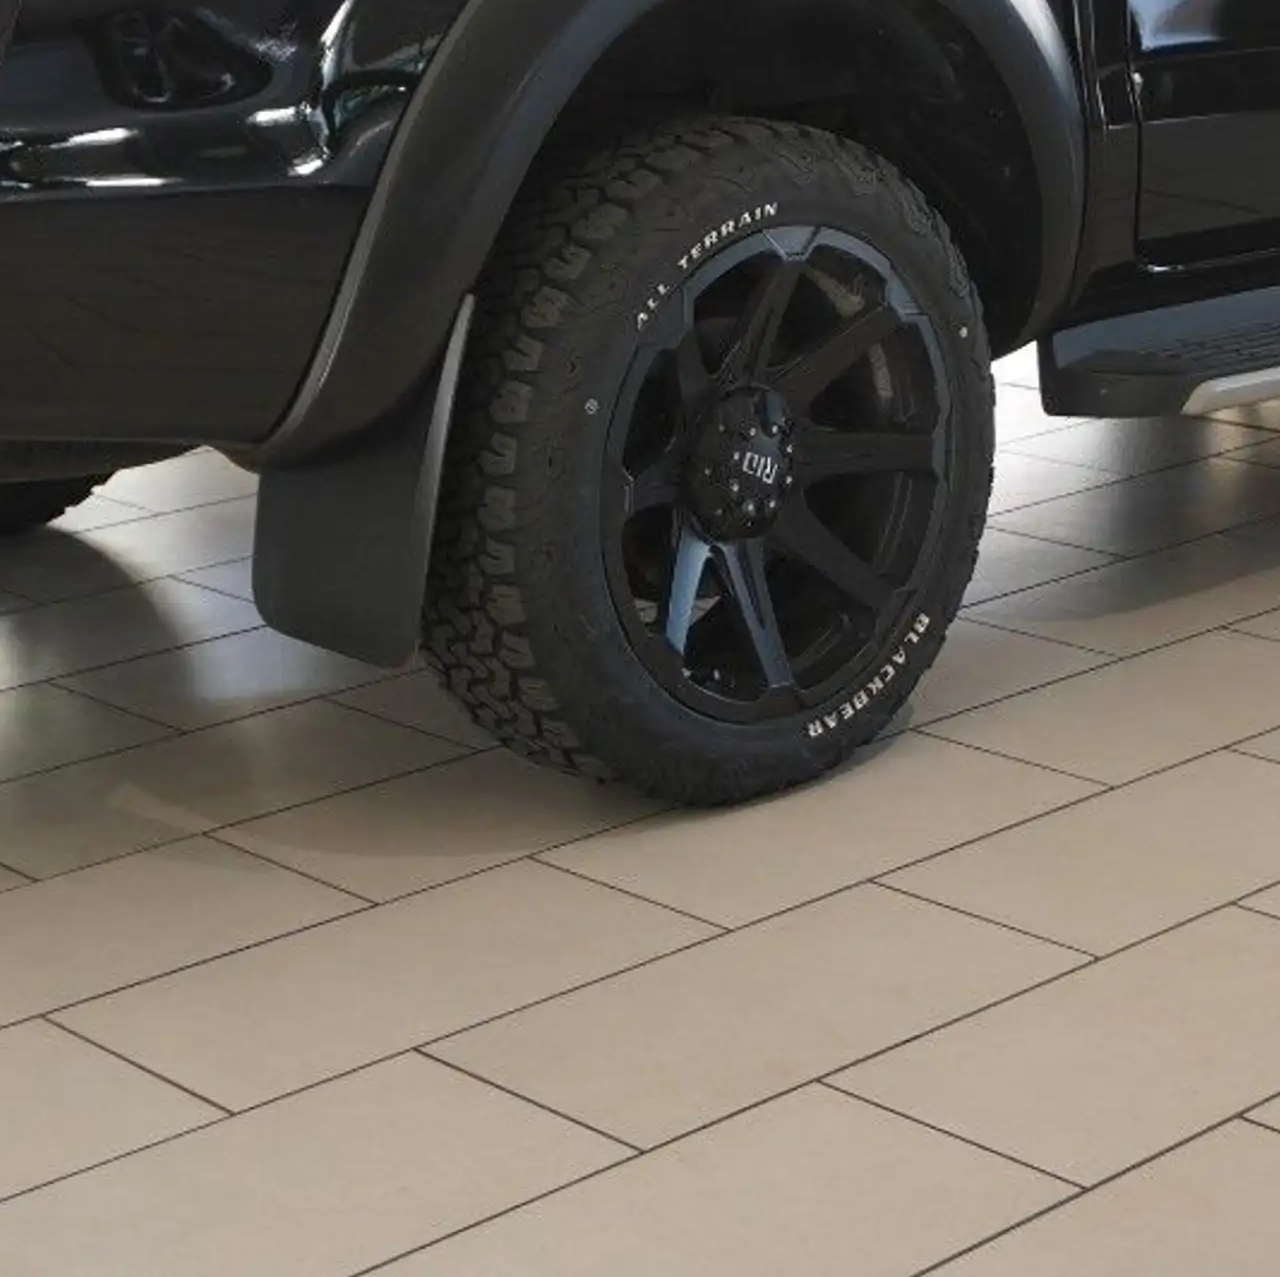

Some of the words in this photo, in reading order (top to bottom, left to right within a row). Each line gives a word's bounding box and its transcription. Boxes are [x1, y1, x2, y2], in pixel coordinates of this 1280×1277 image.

[637, 283, 672, 330] ALL
[677, 201, 778, 269] TERRAIN
[808, 612, 930, 737] BLACKBEAR
